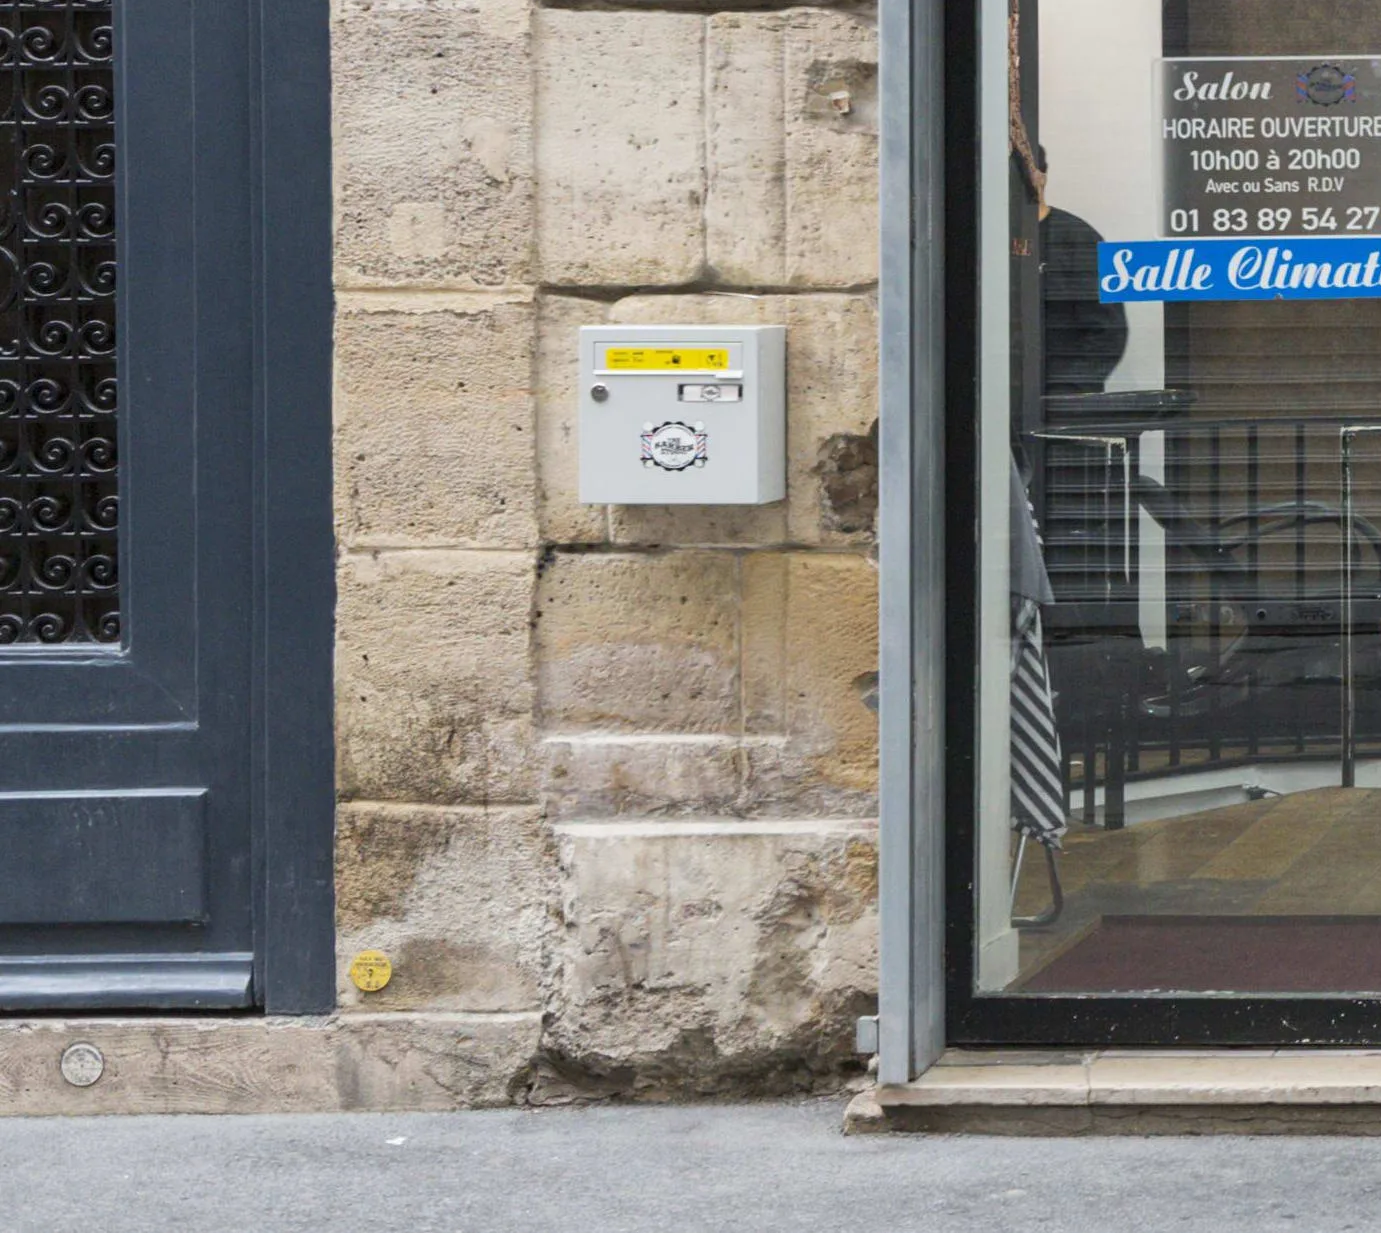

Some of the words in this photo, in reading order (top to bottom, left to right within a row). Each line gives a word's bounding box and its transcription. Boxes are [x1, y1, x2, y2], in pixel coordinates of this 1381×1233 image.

[1173, 71, 1274, 102] Salon
[1163, 118, 1255, 139] HORAIRE
[1190, 150, 1259, 171] 10h00
[1265, 149, 1280, 170] à
[1288, 148, 1361, 170] 20h00
[1205, 178, 1239, 194] Avec
[1242, 181, 1261, 194] ou
[1264, 178, 1300, 193] Sans
[1307, 177, 1345, 193] R.D.V
[1170, 208, 1200, 233] 01
[1212, 208, 1248, 232] 83
[1257, 208, 1292, 232] 89
[1301, 207, 1338, 231] 54
[1345, 206, 1381, 231] 27
[1101, 247, 1215, 294] Salle
